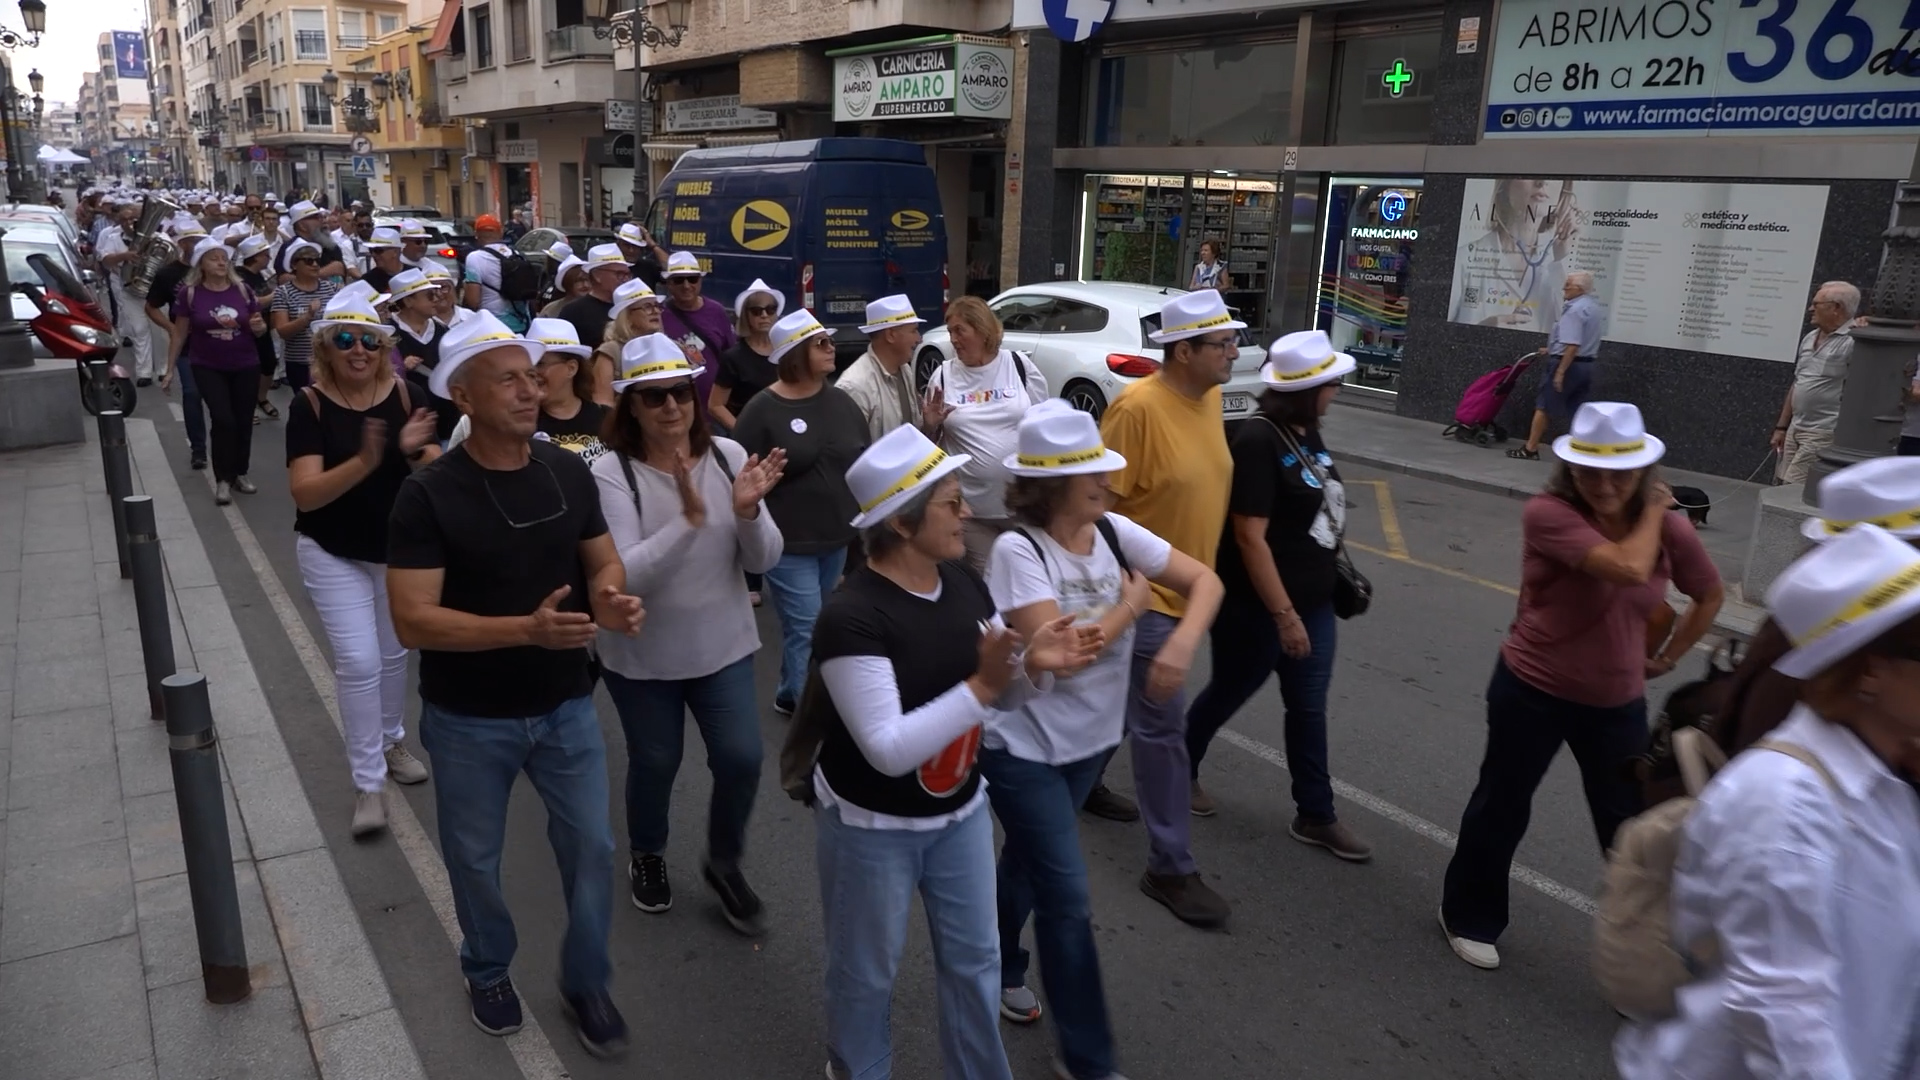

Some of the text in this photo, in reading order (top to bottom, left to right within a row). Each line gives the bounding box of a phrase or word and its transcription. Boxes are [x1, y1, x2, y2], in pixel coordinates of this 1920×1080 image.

[1518, 0, 1714, 49] ABRIMOS
[881, 52, 946, 75] CARNICERIA
[961, 74, 1009, 88] AMPARO
[1513, 57, 1706, 93] de 8h a 22h
[843, 80, 872, 94] AMPARO
[880, 75, 945, 101] AMPARO
[690, 108, 738, 121] GUARDAMAR
[880, 101, 946, 115] SUPERMERCADO
[1285, 152, 1297, 166] 29
[676, 181, 713, 196] MUEBLES
[673, 203, 700, 221] MÖBEL
[825, 208, 868, 216] MUEBLES
[1593, 209, 1658, 220] especialidades
[1701, 210, 1749, 223] estética y
[825, 218, 859, 227] MÖBEL
[1700, 220, 1790, 232] medicina estética.
[671, 231, 706, 247] MEUBLES
[1351, 227, 1418, 240] FARMACIAMO
[1348, 254, 1401, 271] CUIDARTE
[1365, 273, 1383, 282] COMO
[1383, 275, 1397, 283] ERES
